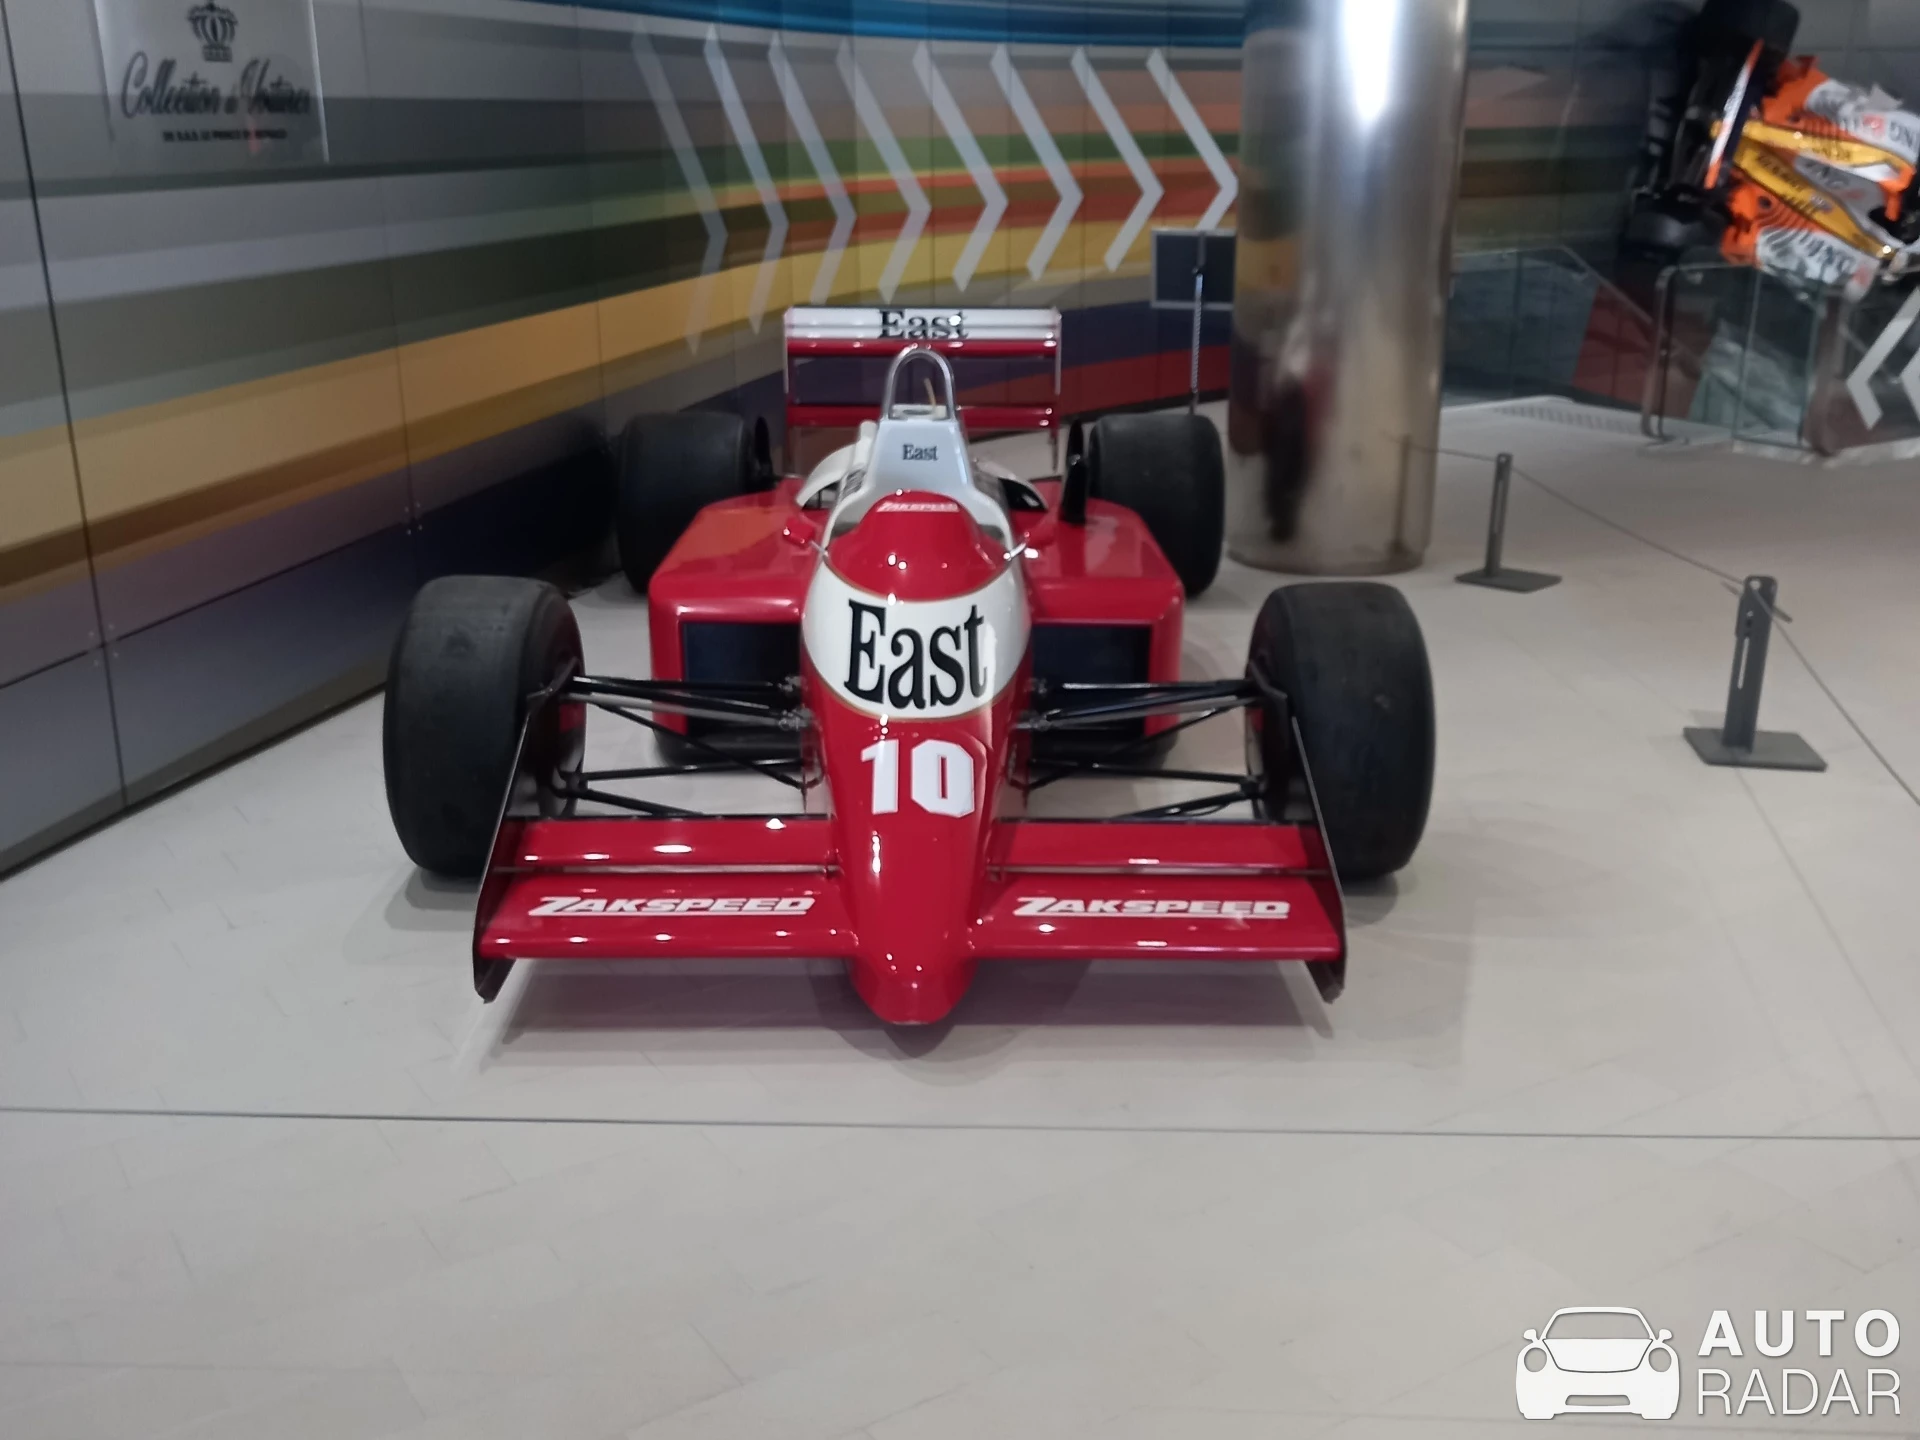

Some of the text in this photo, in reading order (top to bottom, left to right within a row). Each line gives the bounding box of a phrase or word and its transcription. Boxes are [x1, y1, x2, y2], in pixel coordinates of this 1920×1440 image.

[879, 310, 968, 339] East
[902, 443, 938, 461] East
[843, 599, 988, 709] East
[861, 739, 975, 818] 10
[528, 896, 815, 916] ZAKSPEED
[1012, 897, 1290, 919] ZAKSPEED
